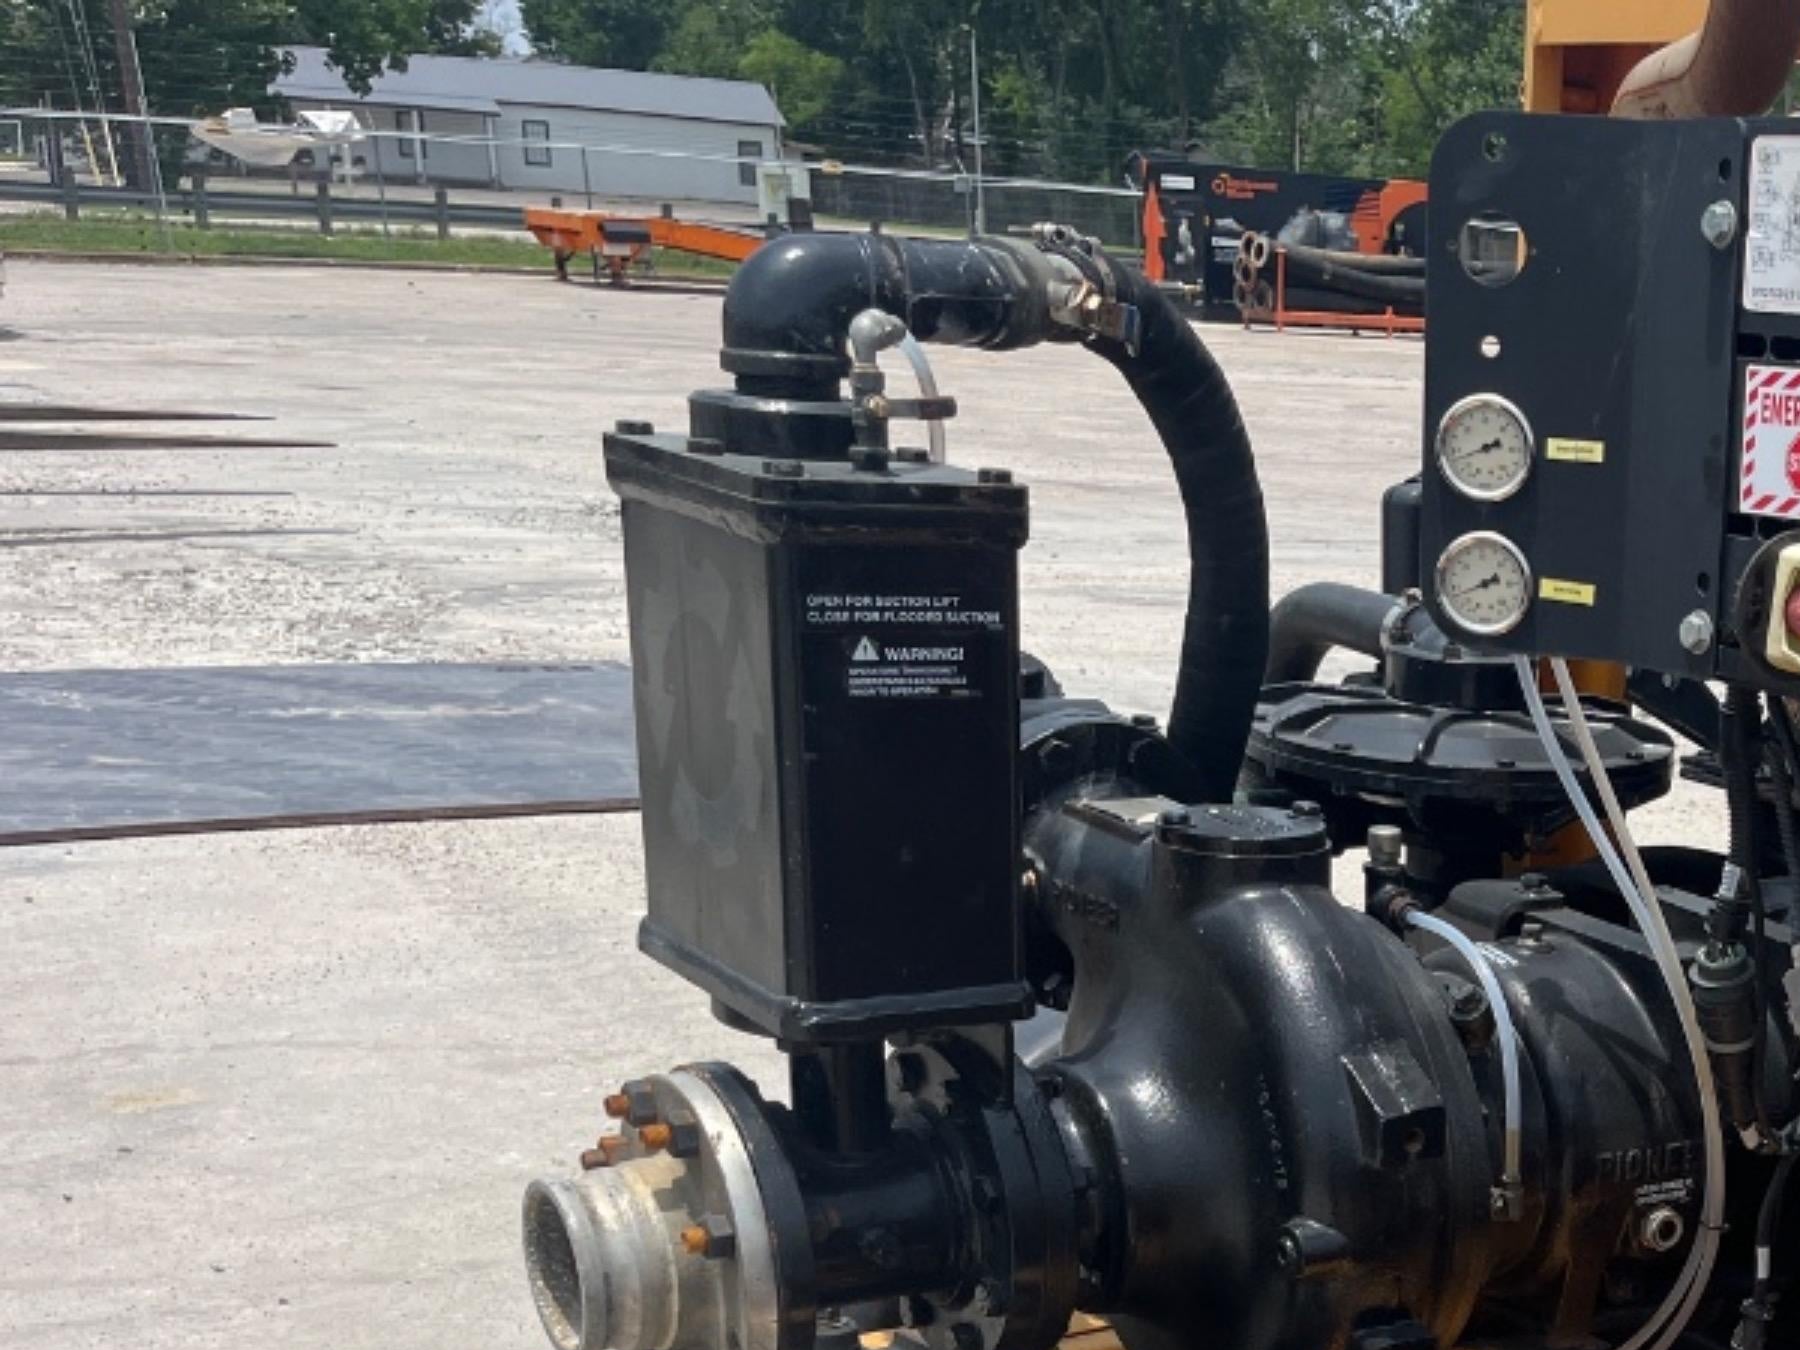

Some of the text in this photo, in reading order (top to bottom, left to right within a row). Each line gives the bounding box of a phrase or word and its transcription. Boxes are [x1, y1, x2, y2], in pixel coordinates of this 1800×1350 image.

[807, 595, 959, 607] OPEN FOR SUCTION LIFT
[807, 611, 1000, 625] CLOSE FOR FLOODED SUCTION
[884, 647, 964, 661] WARNING!
